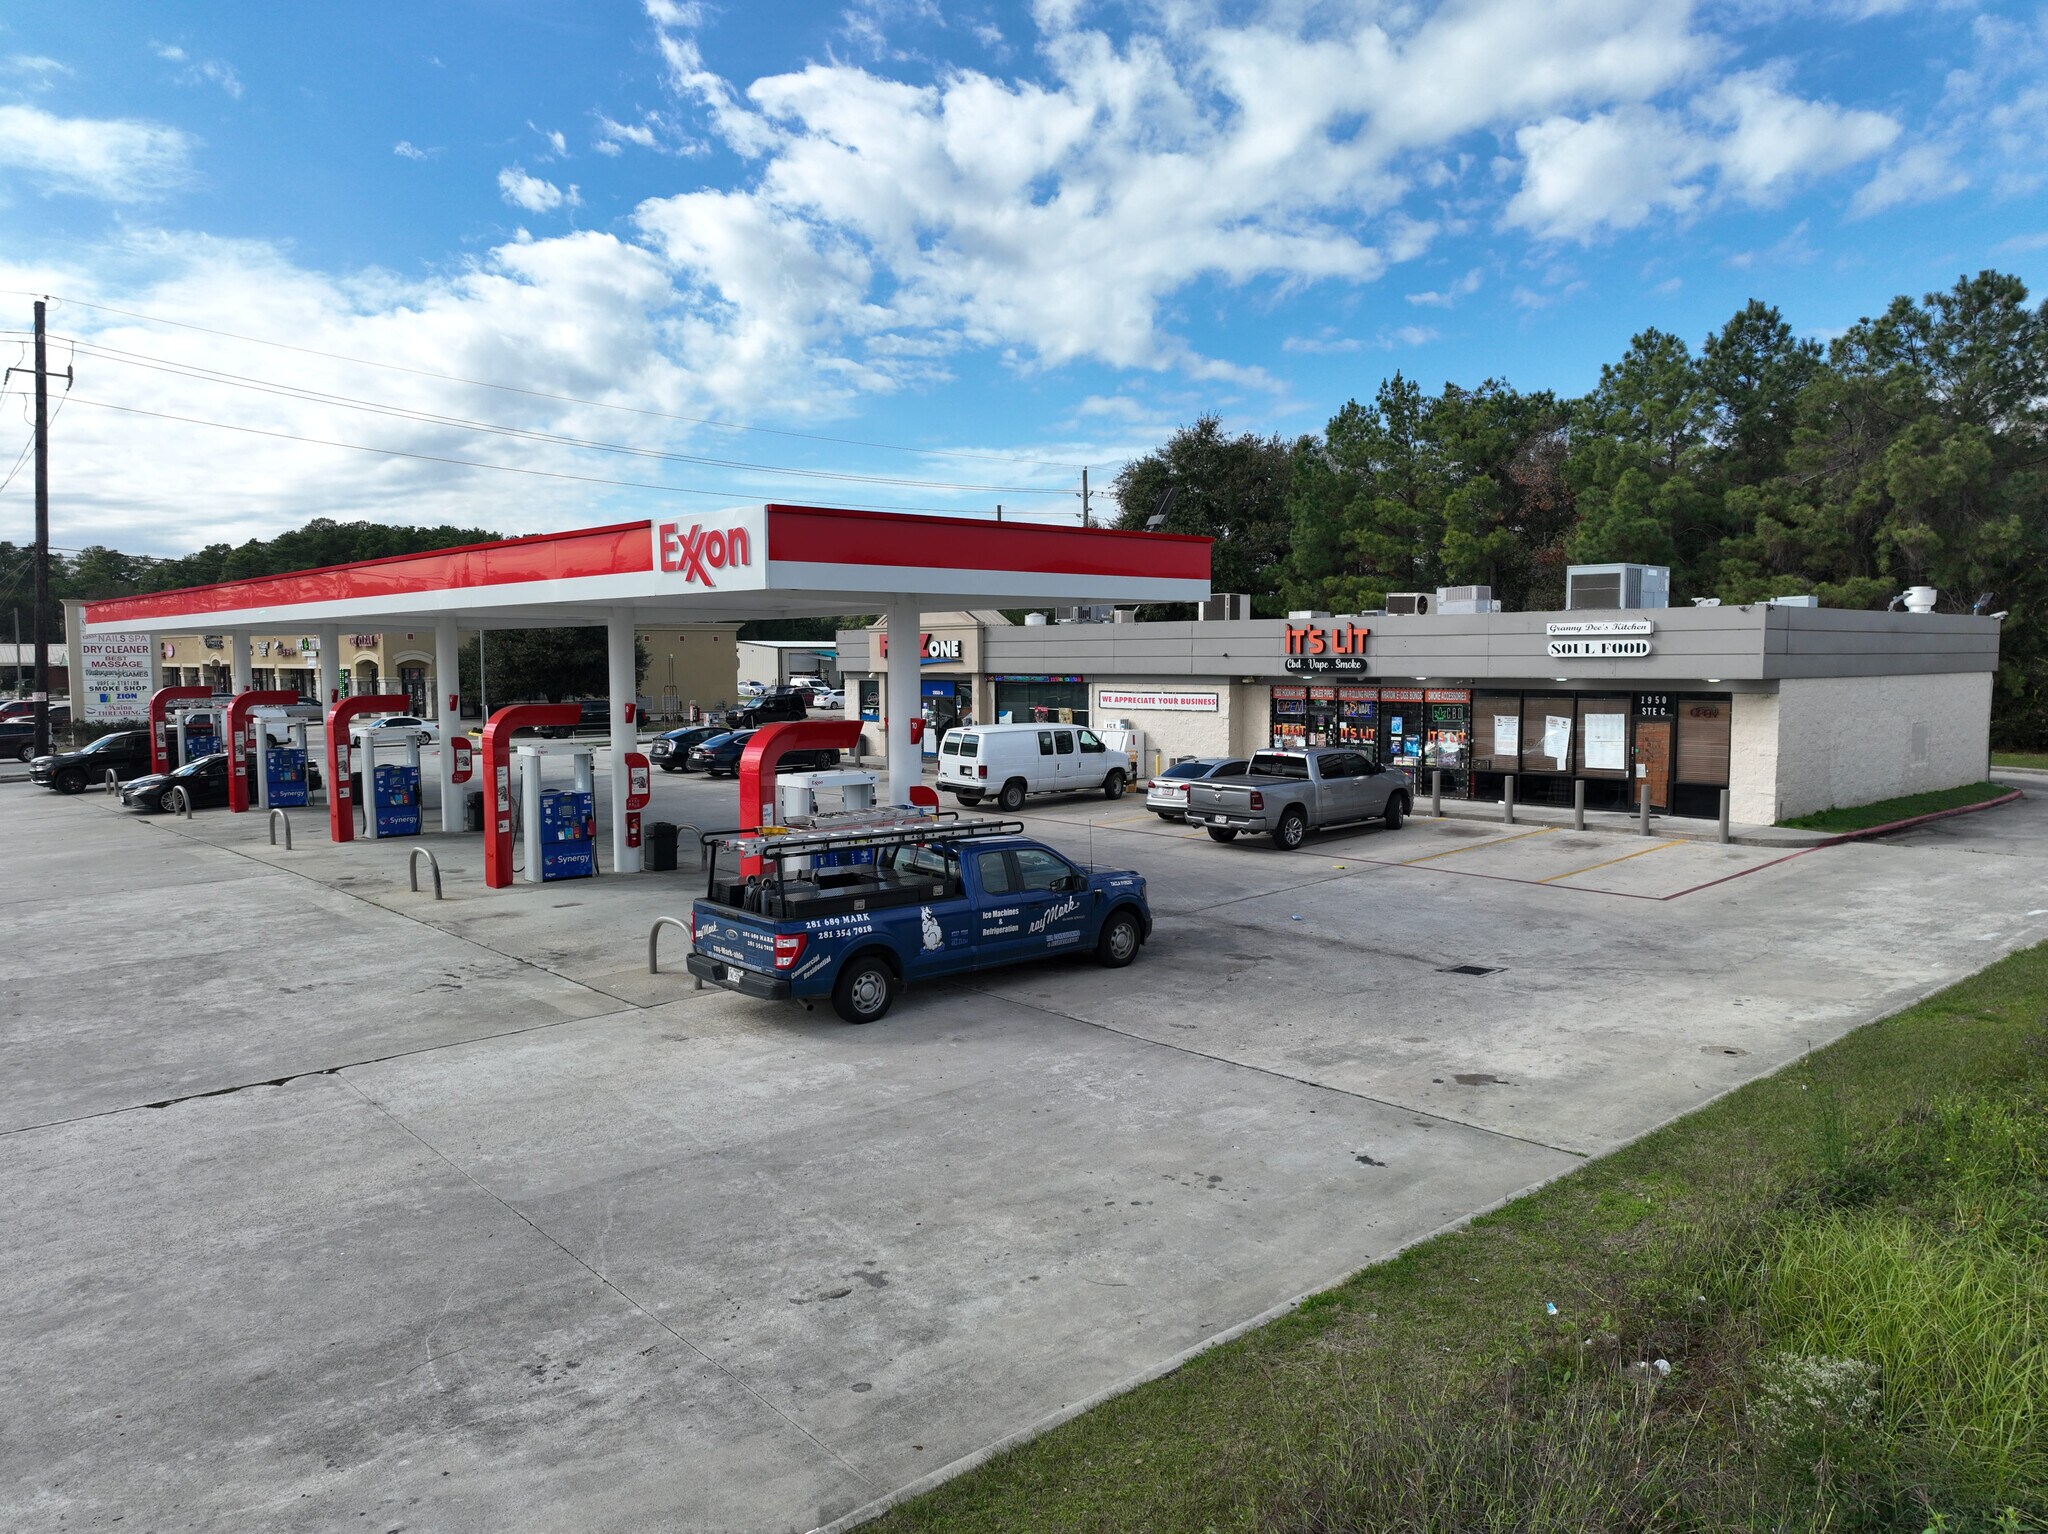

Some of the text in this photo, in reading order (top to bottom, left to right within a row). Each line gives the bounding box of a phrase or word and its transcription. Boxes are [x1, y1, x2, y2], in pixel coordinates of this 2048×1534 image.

[659, 523, 751, 587] Exxon
[1549, 624, 1582, 633] Granny
[98, 634, 126, 642] NAILS
[128, 634, 148, 642] SPA
[1332, 622, 1370, 654] LIT
[83, 646, 149, 654] DRY CLEANER
[1551, 643, 1647, 654] SOUL FOOD
[1308, 659, 1329, 672] Vape
[1335, 658, 1361, 669] Smoke
[1641, 696, 1667, 704] 1950
[1361, 726, 1375, 738] LIT
[279, 790, 304, 798] Synergy
[558, 854, 590, 864] Synergy
[993, 908, 1019, 918] Machines
[824, 918, 840, 926] 689
[842, 913, 870, 923] MARK
[818, 925, 872, 939] 281 354 7018
[982, 925, 1019, 936] Refrigeration
